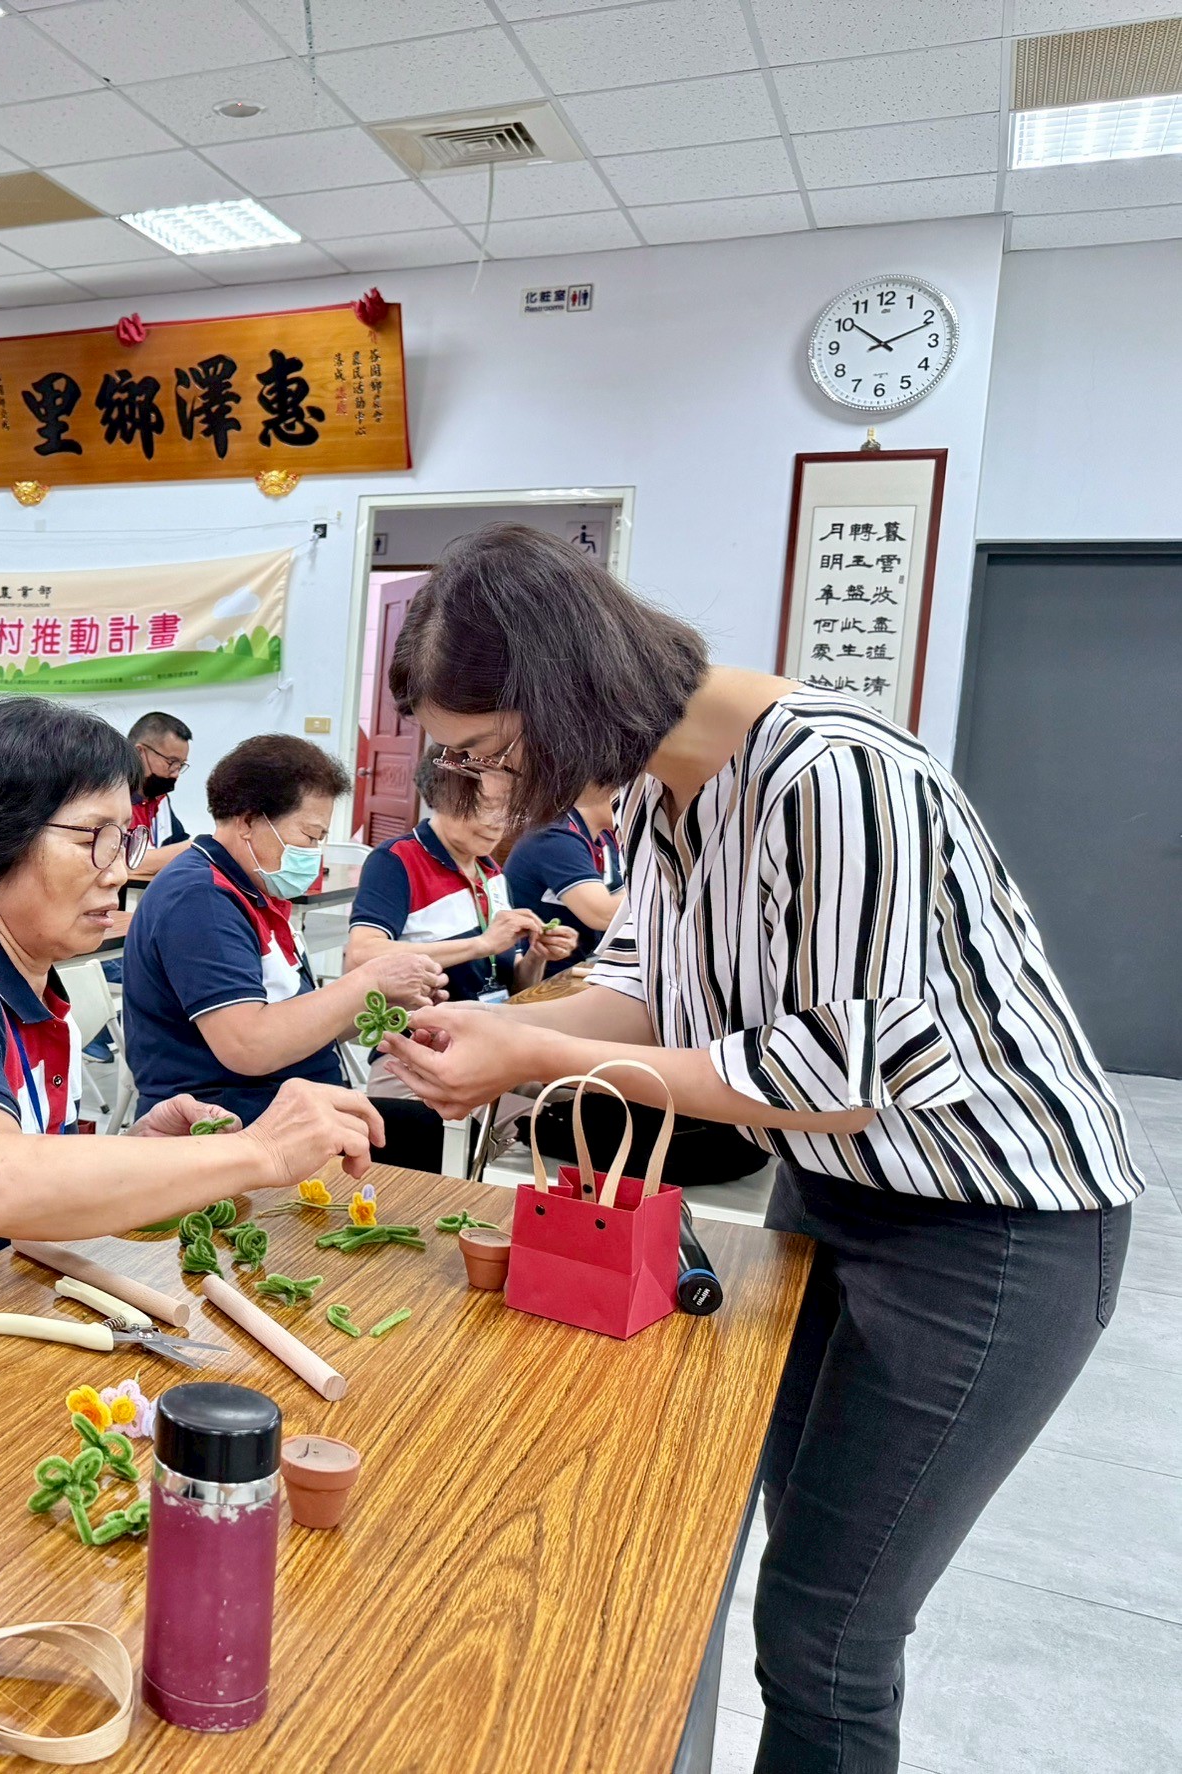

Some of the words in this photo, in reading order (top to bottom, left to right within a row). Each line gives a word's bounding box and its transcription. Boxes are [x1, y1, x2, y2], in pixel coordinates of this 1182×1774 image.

[877, 291, 896, 306] 12
[906, 294, 914, 309] 1
[852, 299, 869, 314] 11
[923, 310, 935, 325] 2
[835, 318, 855, 332] 10
[927, 333, 939, 348] 3
[828, 341, 840, 355] 9
[834, 364, 846, 377] 8
[917, 357, 930, 371] 4
[852, 379, 862, 392] 7
[900, 375, 912, 389] 5
[873, 383, 885, 397] 6
[863, 521, 906, 714] 暮雲收盡溢清
